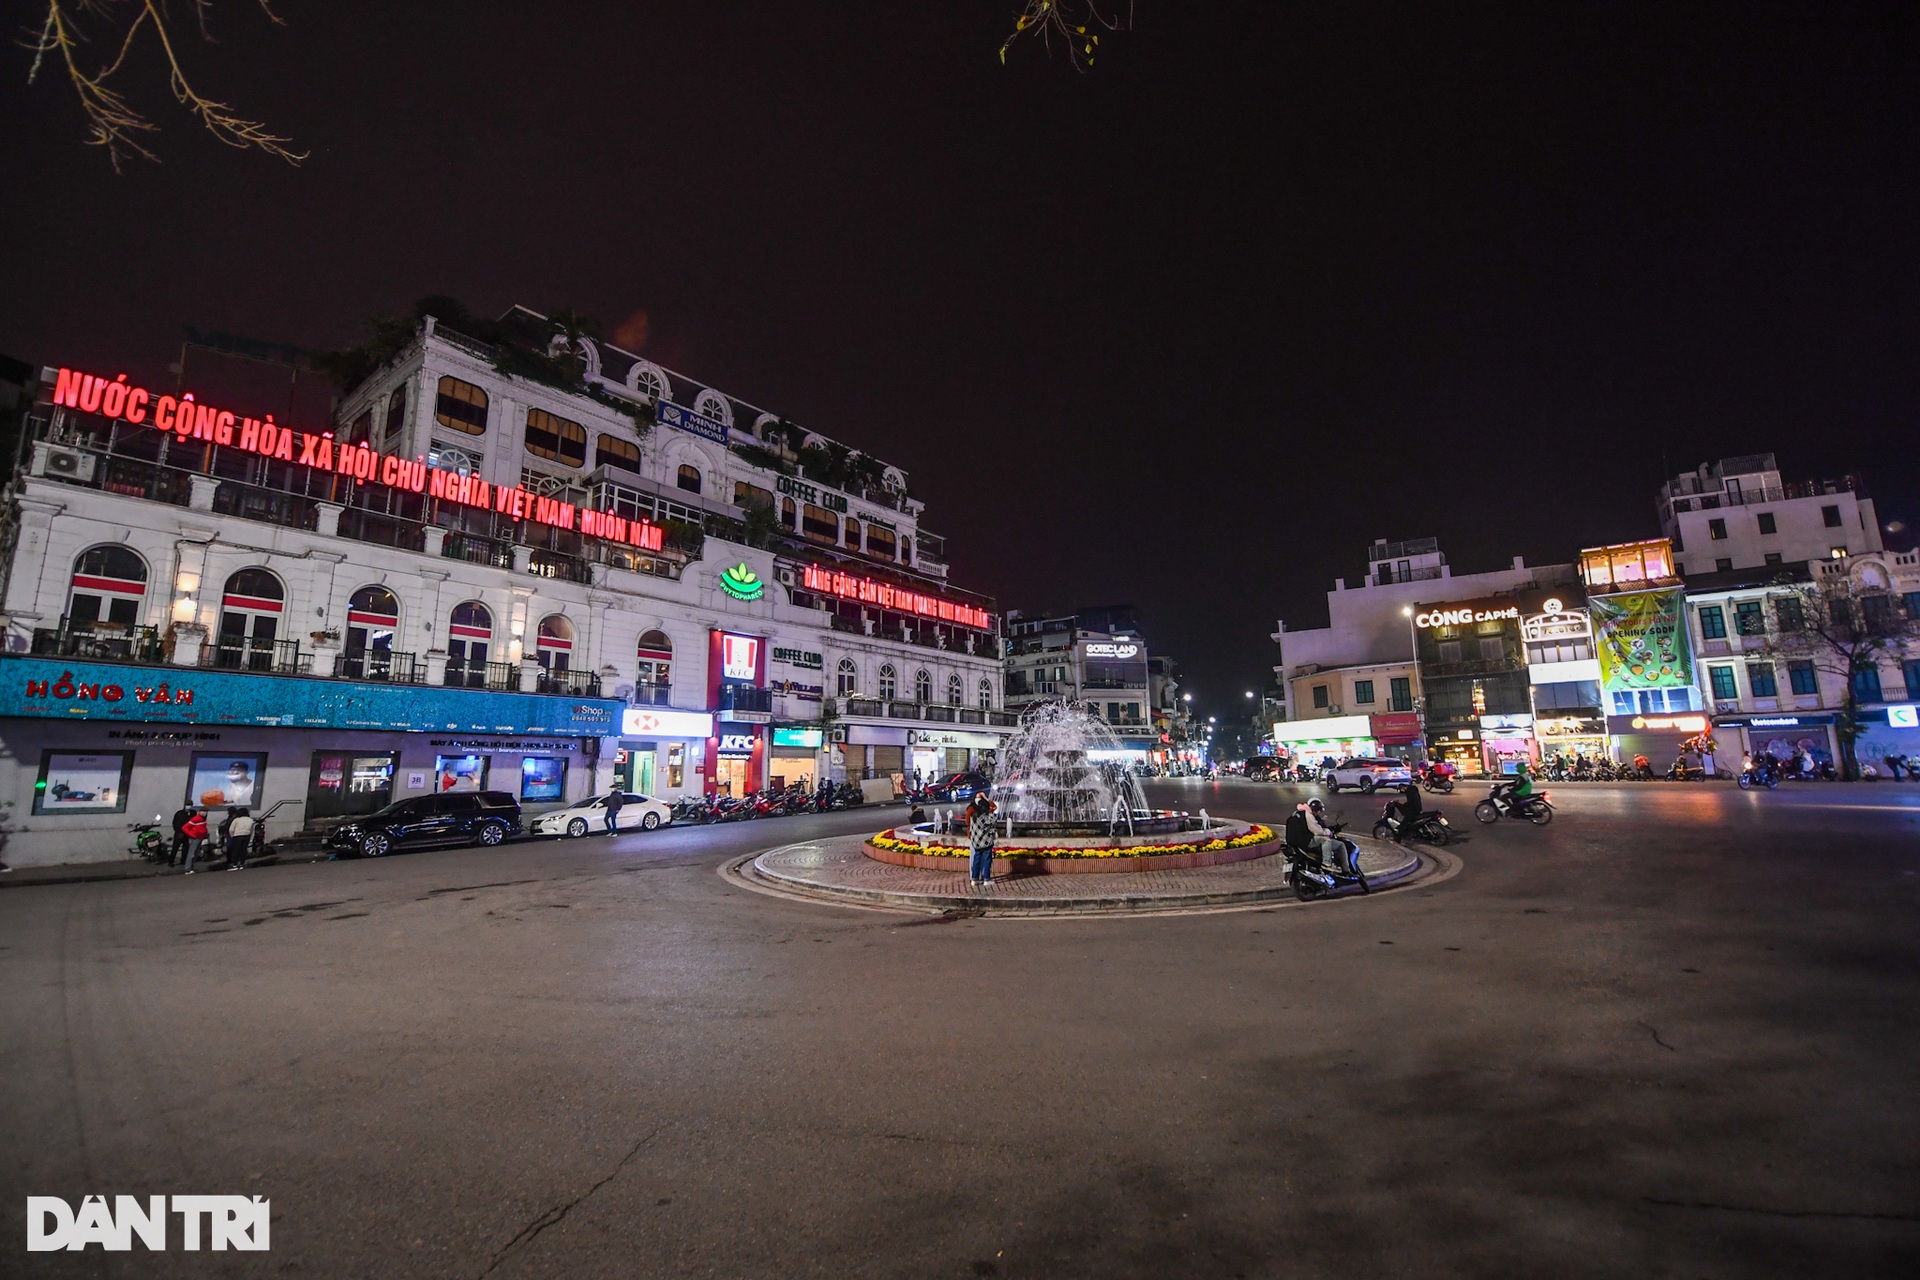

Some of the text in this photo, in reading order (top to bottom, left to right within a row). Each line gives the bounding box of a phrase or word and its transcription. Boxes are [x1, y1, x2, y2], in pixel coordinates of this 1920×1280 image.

[684, 421, 725, 442] DIAMOND
[689, 415, 722, 433] MINH
[53, 368, 663, 551] NƯỚC CỘNG HÒA XÃ HỘI CHỦ NGHĨA VIỆT NAM MUÔN NĂM
[776, 476, 817, 504] COFFEE
[804, 563, 831, 592] ĐẢNG
[832, 571, 857, 599] CỘNG
[858, 577, 876, 602] SẢN
[878, 584, 895, 609] VIỆT
[895, 590, 913, 611] NAM
[913, 595, 937, 617] QUANG
[954, 604, 974, 625] MUÔN
[973, 608, 988, 629] NĂM
[1415, 609, 1473, 628] CỘNG
[1607, 626, 1675, 639] OPENING SOON
[773, 647, 802, 662] COFFEE
[729, 668, 750, 678] KFC
[26, 670, 194, 705] HỒNG VÂN
[720, 735, 755, 749] KFC
